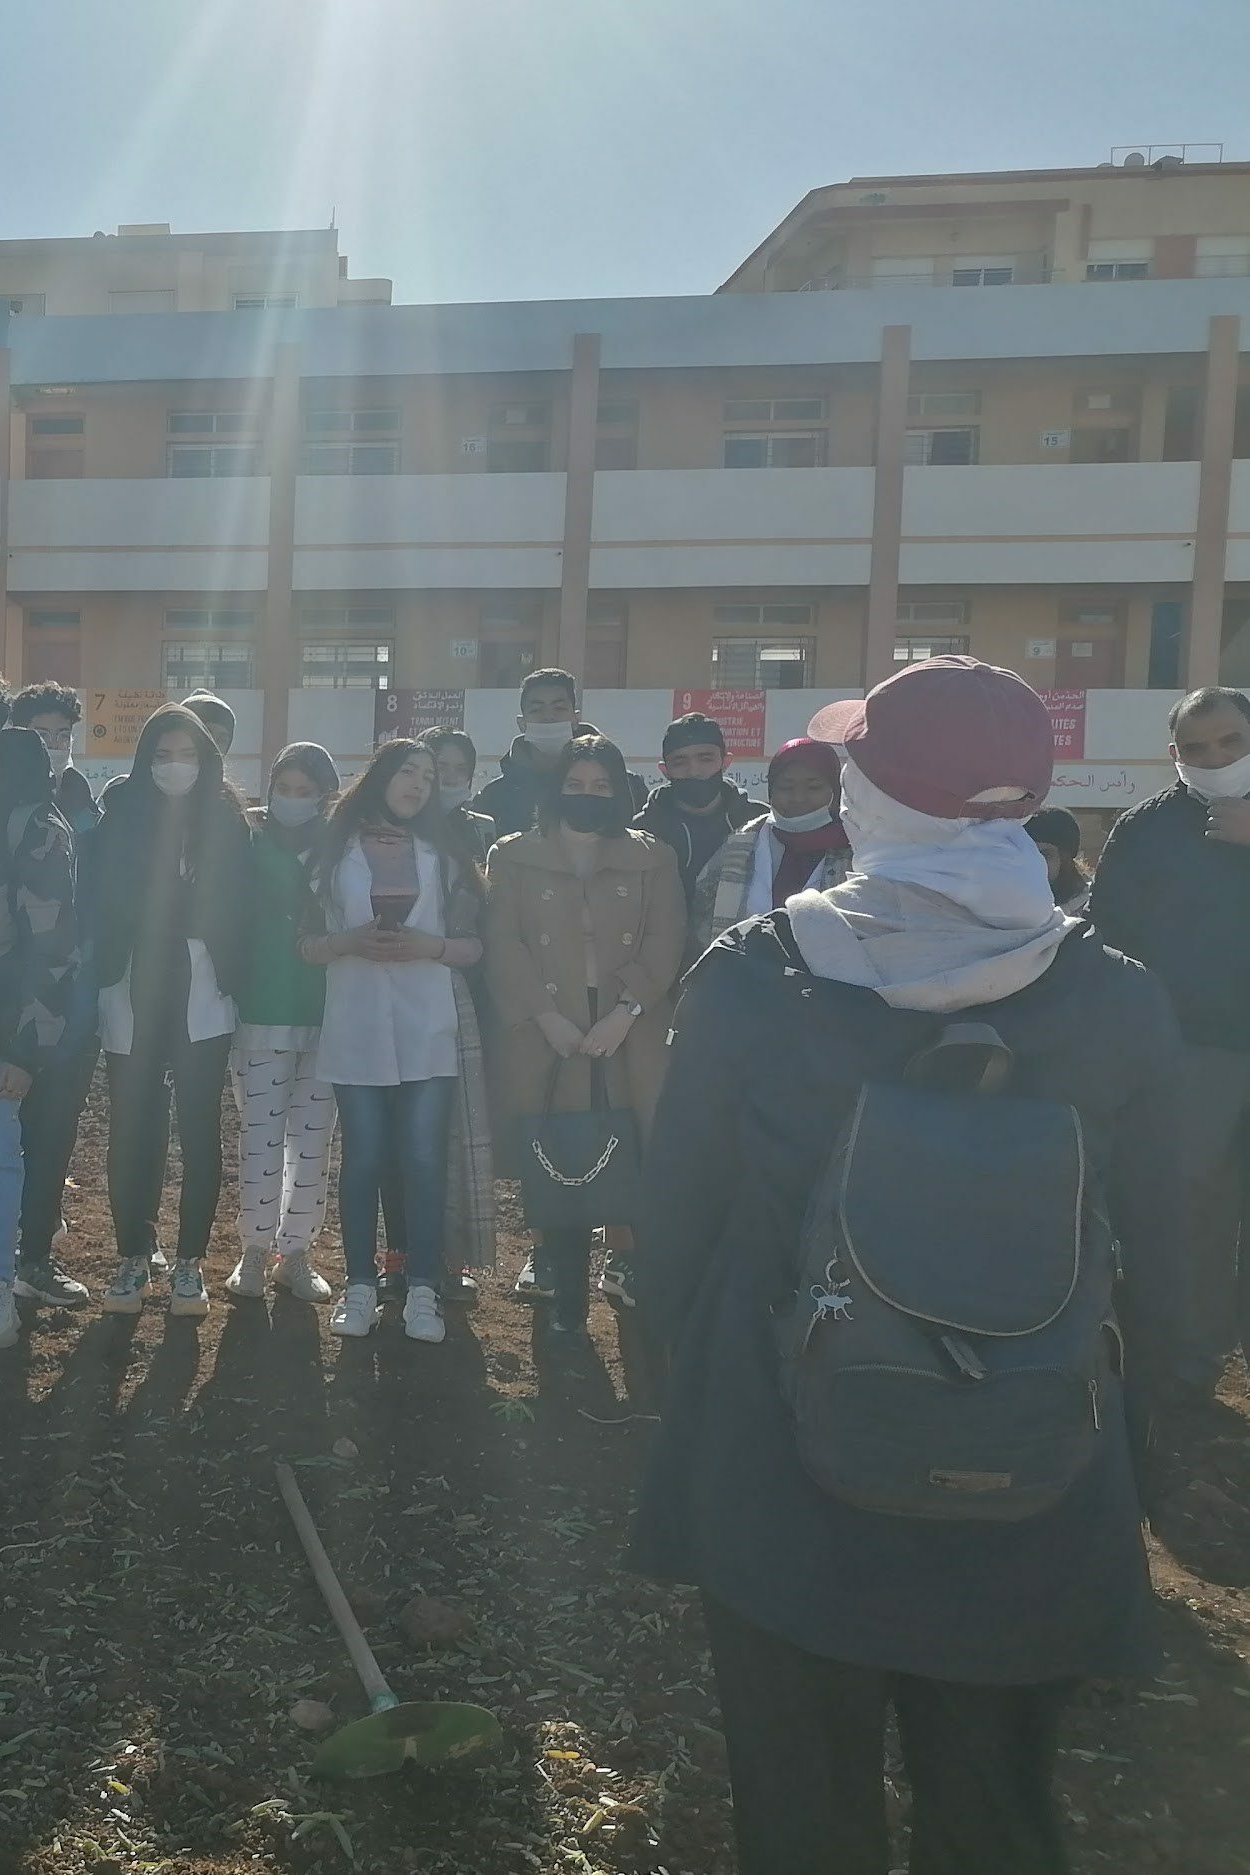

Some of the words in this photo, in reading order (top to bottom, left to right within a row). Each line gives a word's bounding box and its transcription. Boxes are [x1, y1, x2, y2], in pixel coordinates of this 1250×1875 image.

[94, 693, 106, 711] 7
[387, 694, 398, 712] 8
[682, 693, 692, 710] 9
[750, 727, 761, 737] ET
[1100, 770, 1136, 794] رأس
